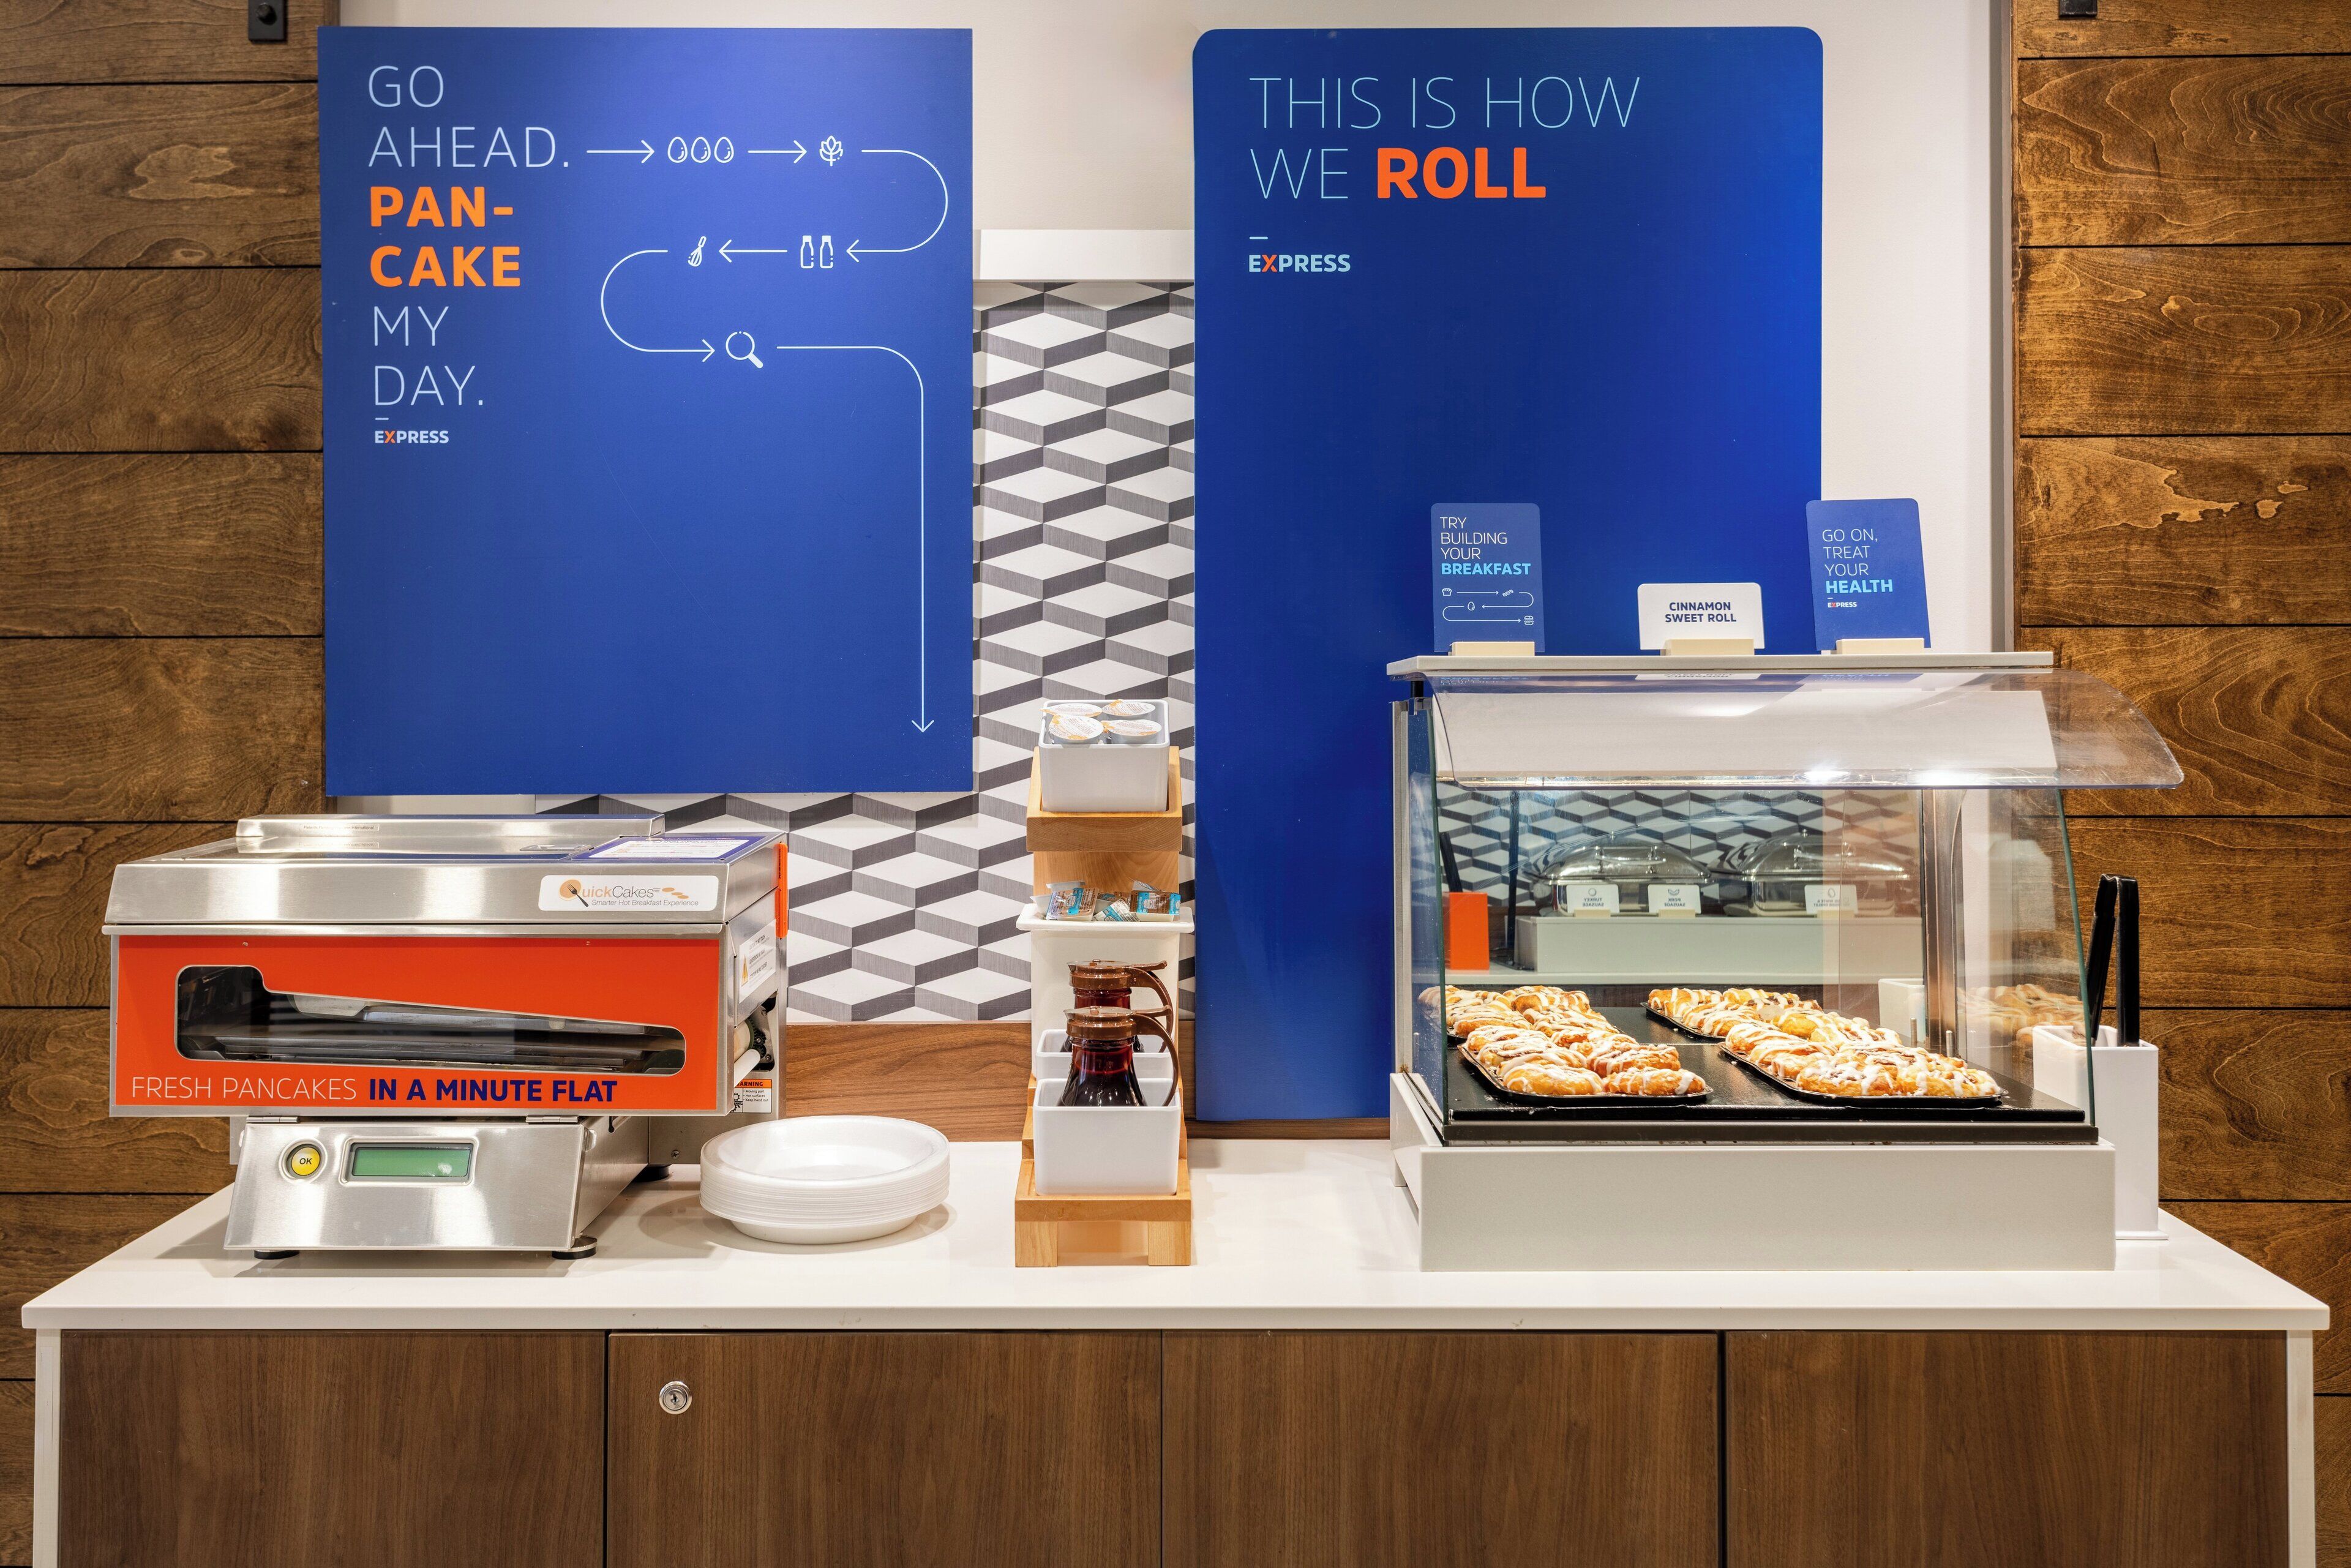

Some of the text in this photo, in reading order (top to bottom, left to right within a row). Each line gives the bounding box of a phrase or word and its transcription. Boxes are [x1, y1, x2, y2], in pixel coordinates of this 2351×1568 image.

[369, 66, 443, 107] GO
[1250, 77, 1640, 129] THIS IS HOW
[369, 127, 568, 167] AHEAD.
[1250, 147, 1547, 199] WE ROLL
[370, 186, 513, 227] PAN-
[370, 246, 520, 287] CAKE
[1249, 254, 1351, 272] EXPRESS
[374, 306, 449, 346] MY
[375, 366, 483, 405] DAY.
[375, 430, 449, 444] EXPRESS
[1440, 517, 1466, 528] TRY
[1441, 532, 1507, 544] BUILDING
[1822, 529, 1877, 542] GO ON,
[1441, 547, 1480, 560] YOUR
[1823, 546, 1870, 559] TREAT
[1442, 563, 1531, 575] BREAKFAST
[1824, 563, 1869, 576] YOUR
[1826, 579, 1892, 594] HEALTH
[1670, 602, 1731, 611] CINNAMON
[1665, 613, 1736, 623] SWEET ROLL
[133, 1077, 617, 1102] FRESH PANCAKES IN A MINUTE FLAT
[299, 1157, 312, 1166] OK
